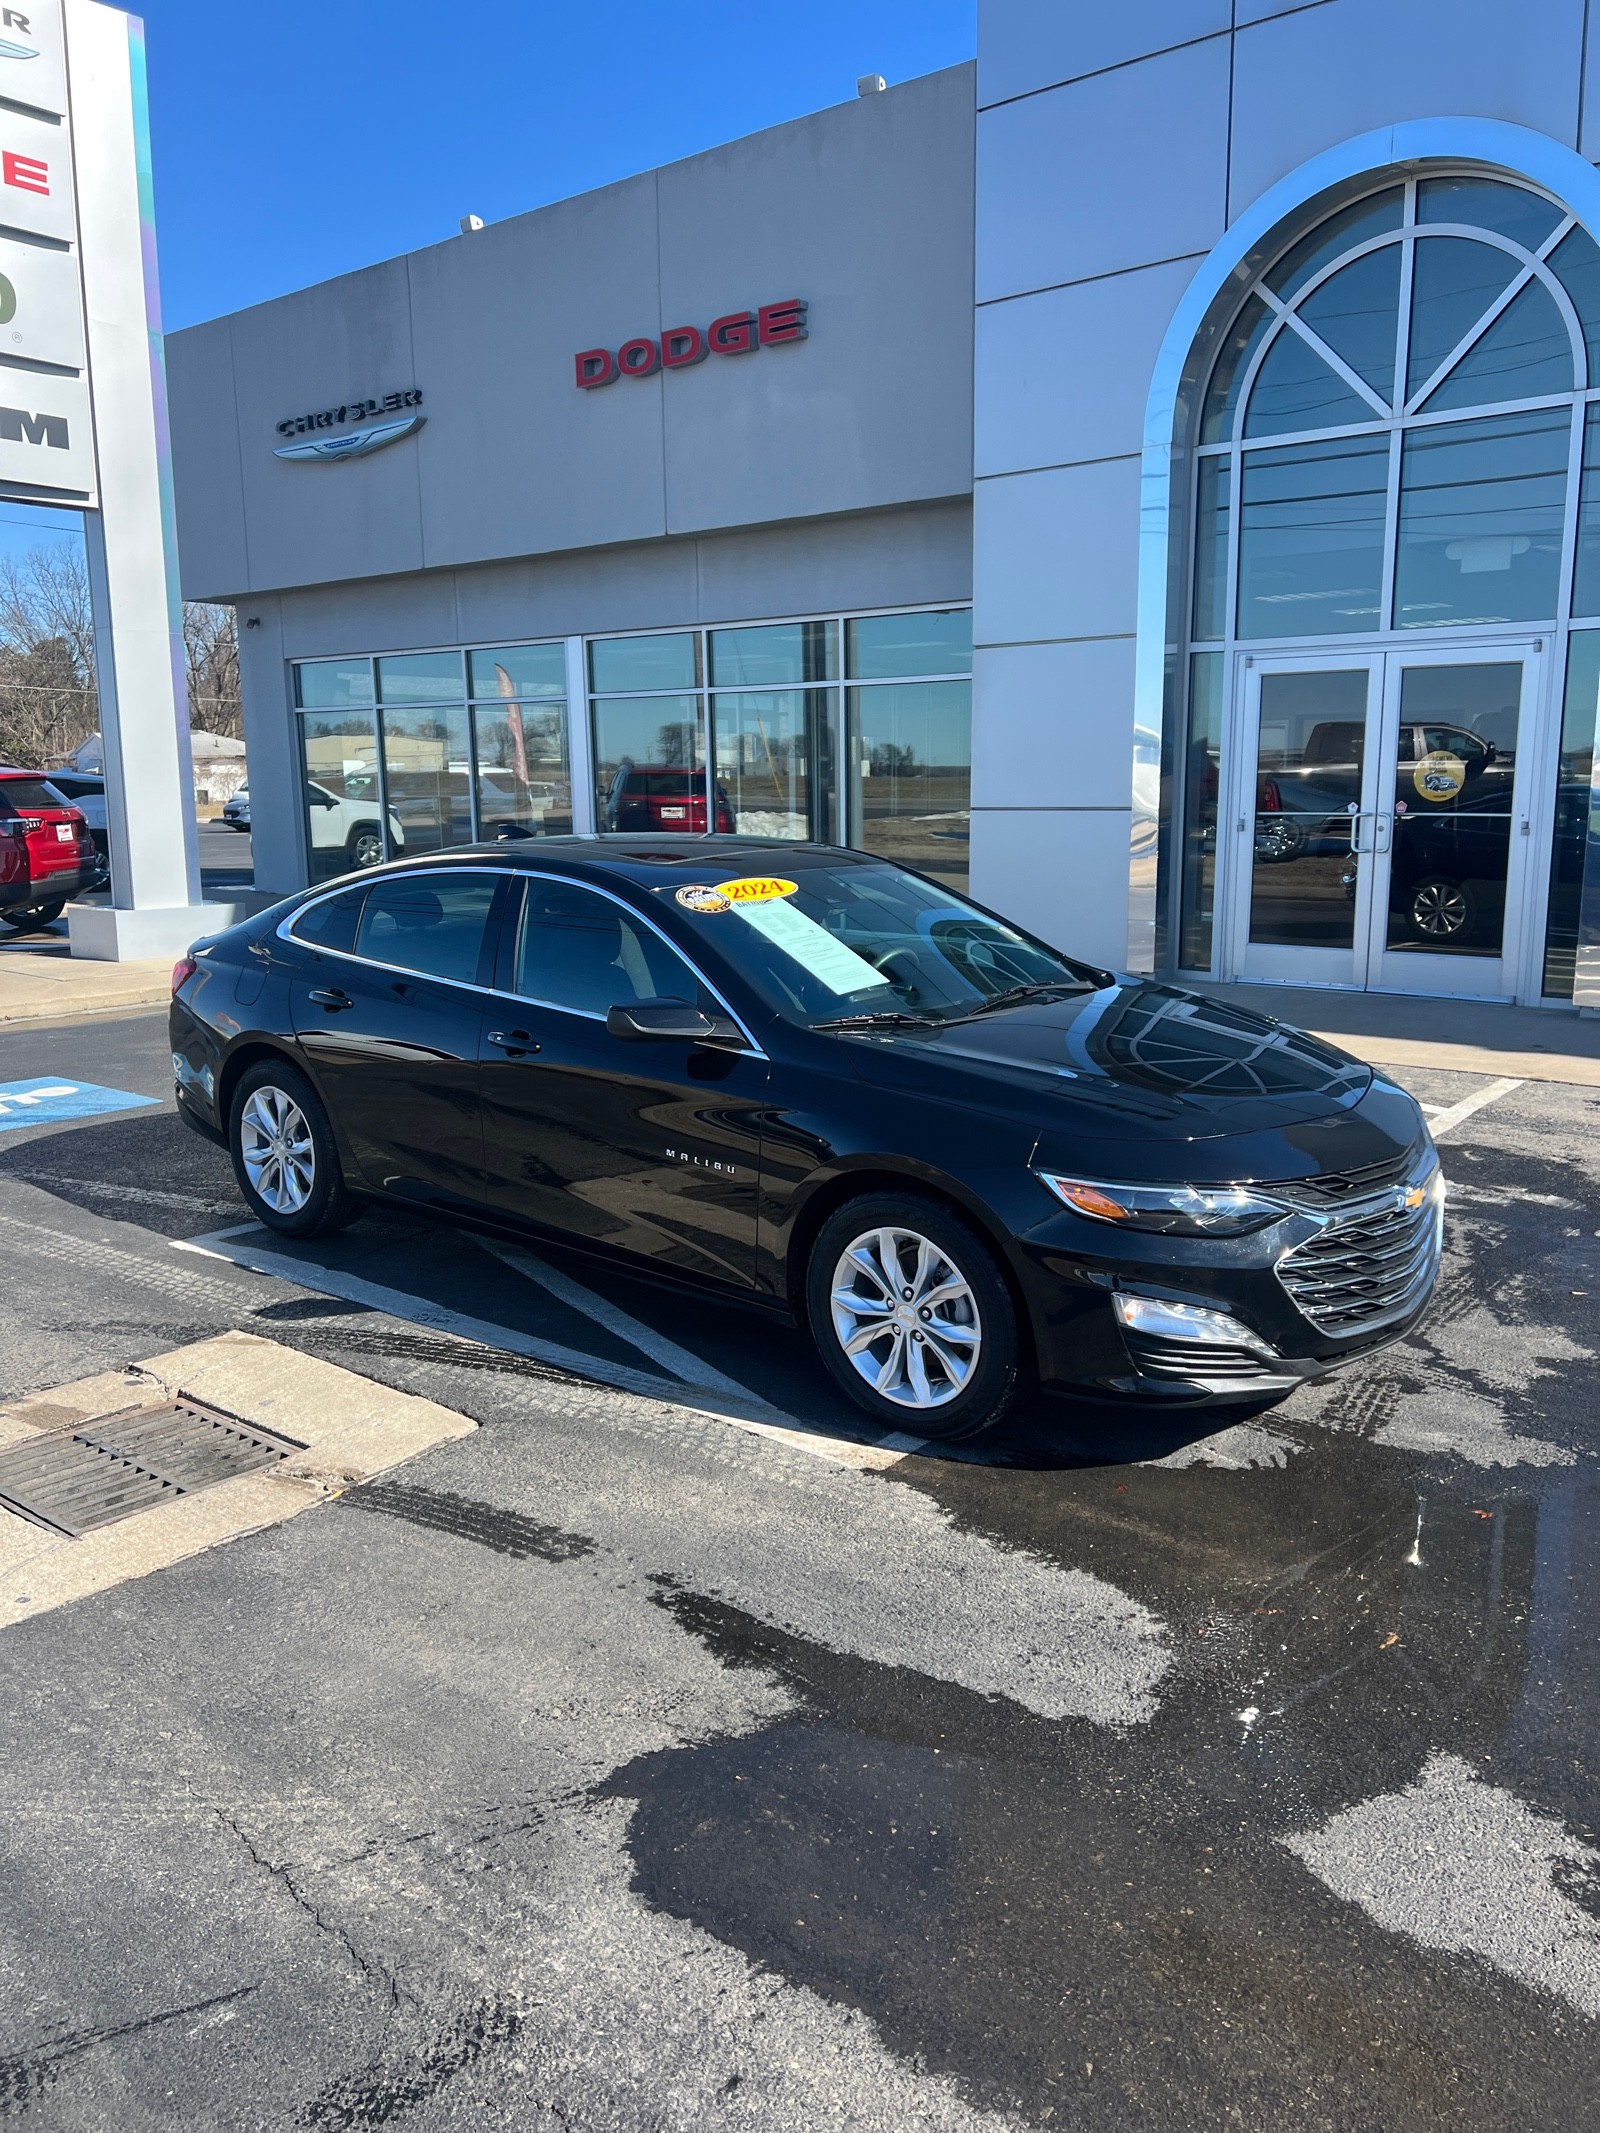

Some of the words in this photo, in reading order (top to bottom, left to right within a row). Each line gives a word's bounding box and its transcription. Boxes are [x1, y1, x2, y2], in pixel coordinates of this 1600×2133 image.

[575, 298, 805, 389] DODGE
[275, 389, 423, 437] CHRYSLER
[728, 880, 785, 899] 2024
[665, 1148, 735, 1174] MALIBU
